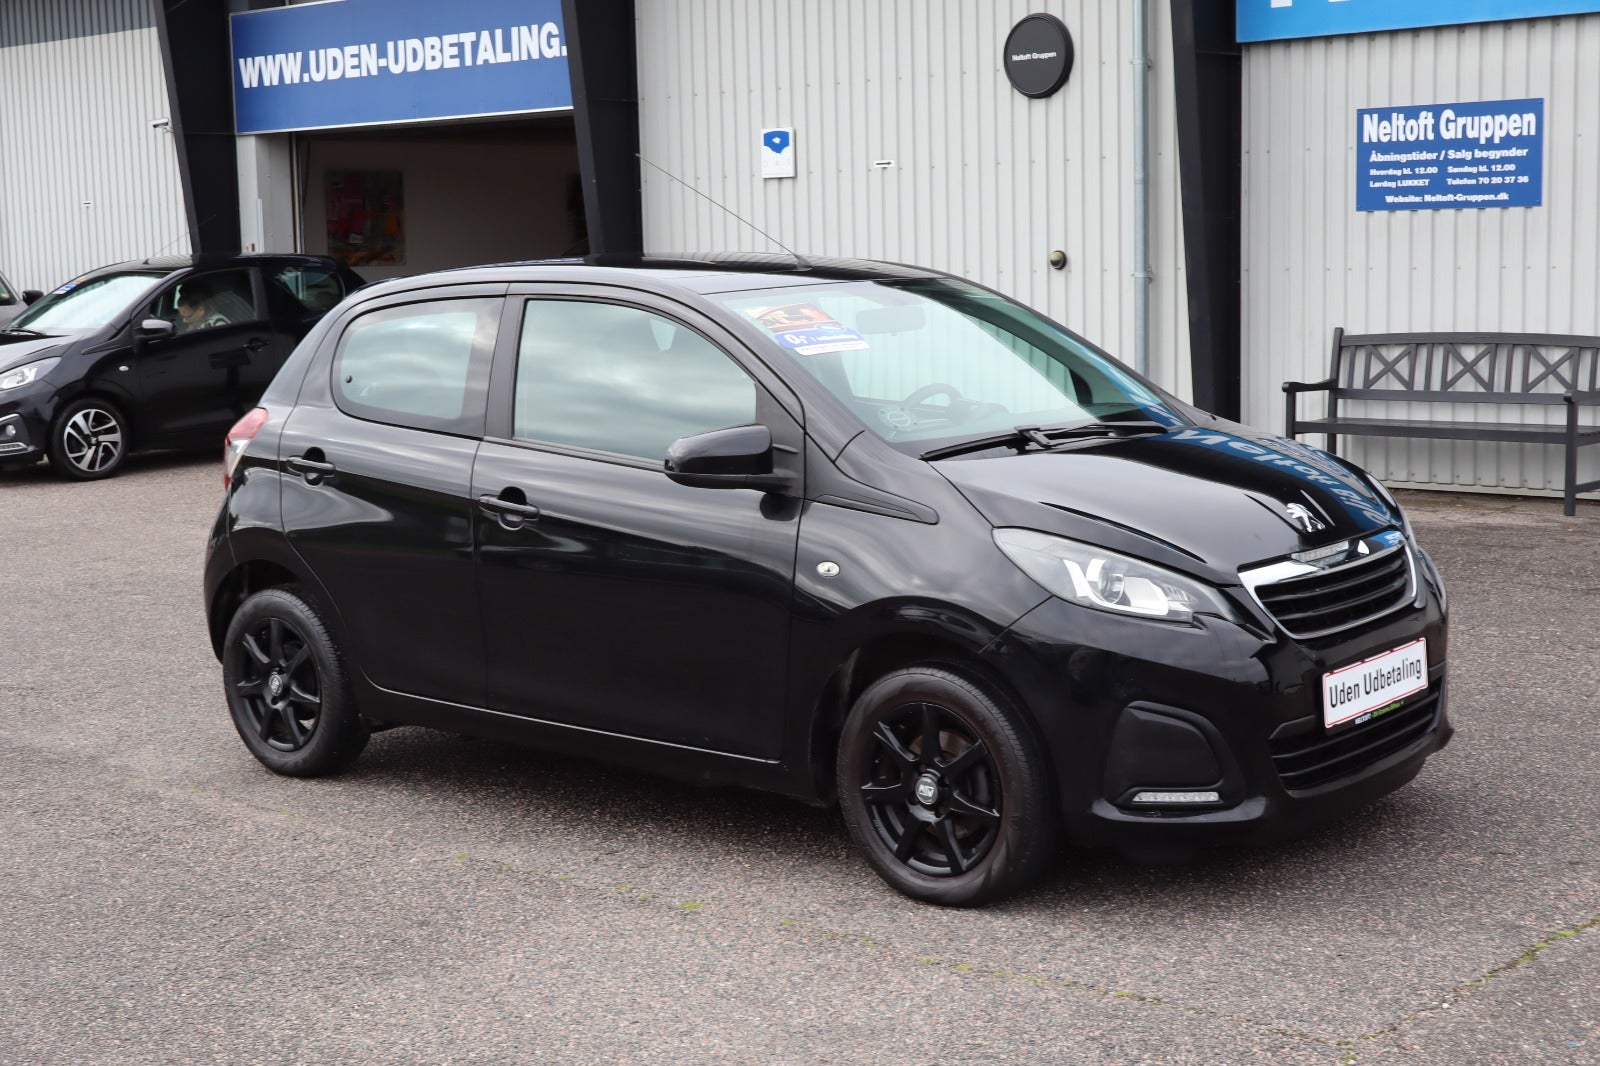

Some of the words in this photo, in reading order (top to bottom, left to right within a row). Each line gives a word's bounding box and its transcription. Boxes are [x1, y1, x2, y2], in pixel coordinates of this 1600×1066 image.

[238, 21, 568, 89] WWW.UDEN-UDBETALING.
[1362, 110, 1435, 143] Neltoft
[1439, 109, 1536, 144] Gruppen
[1369, 150, 1438, 163] Åbningstider
[1447, 149, 1472, 161] Salg
[1474, 147, 1529, 160] begynder
[1369, 168, 1402, 176] Hverdag
[1414, 166, 1438, 174] 12.00
[1447, 165, 1478, 174] Søndag
[1490, 163, 1516, 172] 12.00
[1369, 180, 1397, 189] Lørdag
[1397, 178, 1430, 187] LUKKET
[1478, 177, 1490, 185] 70
[1491, 176, 1503, 184] 20
[1504, 176, 1516, 184] 37
[1385, 195, 1423, 203] Website:
[1329, 682, 1360, 708] Uden
[1363, 658, 1421, 695] Udbetaling
